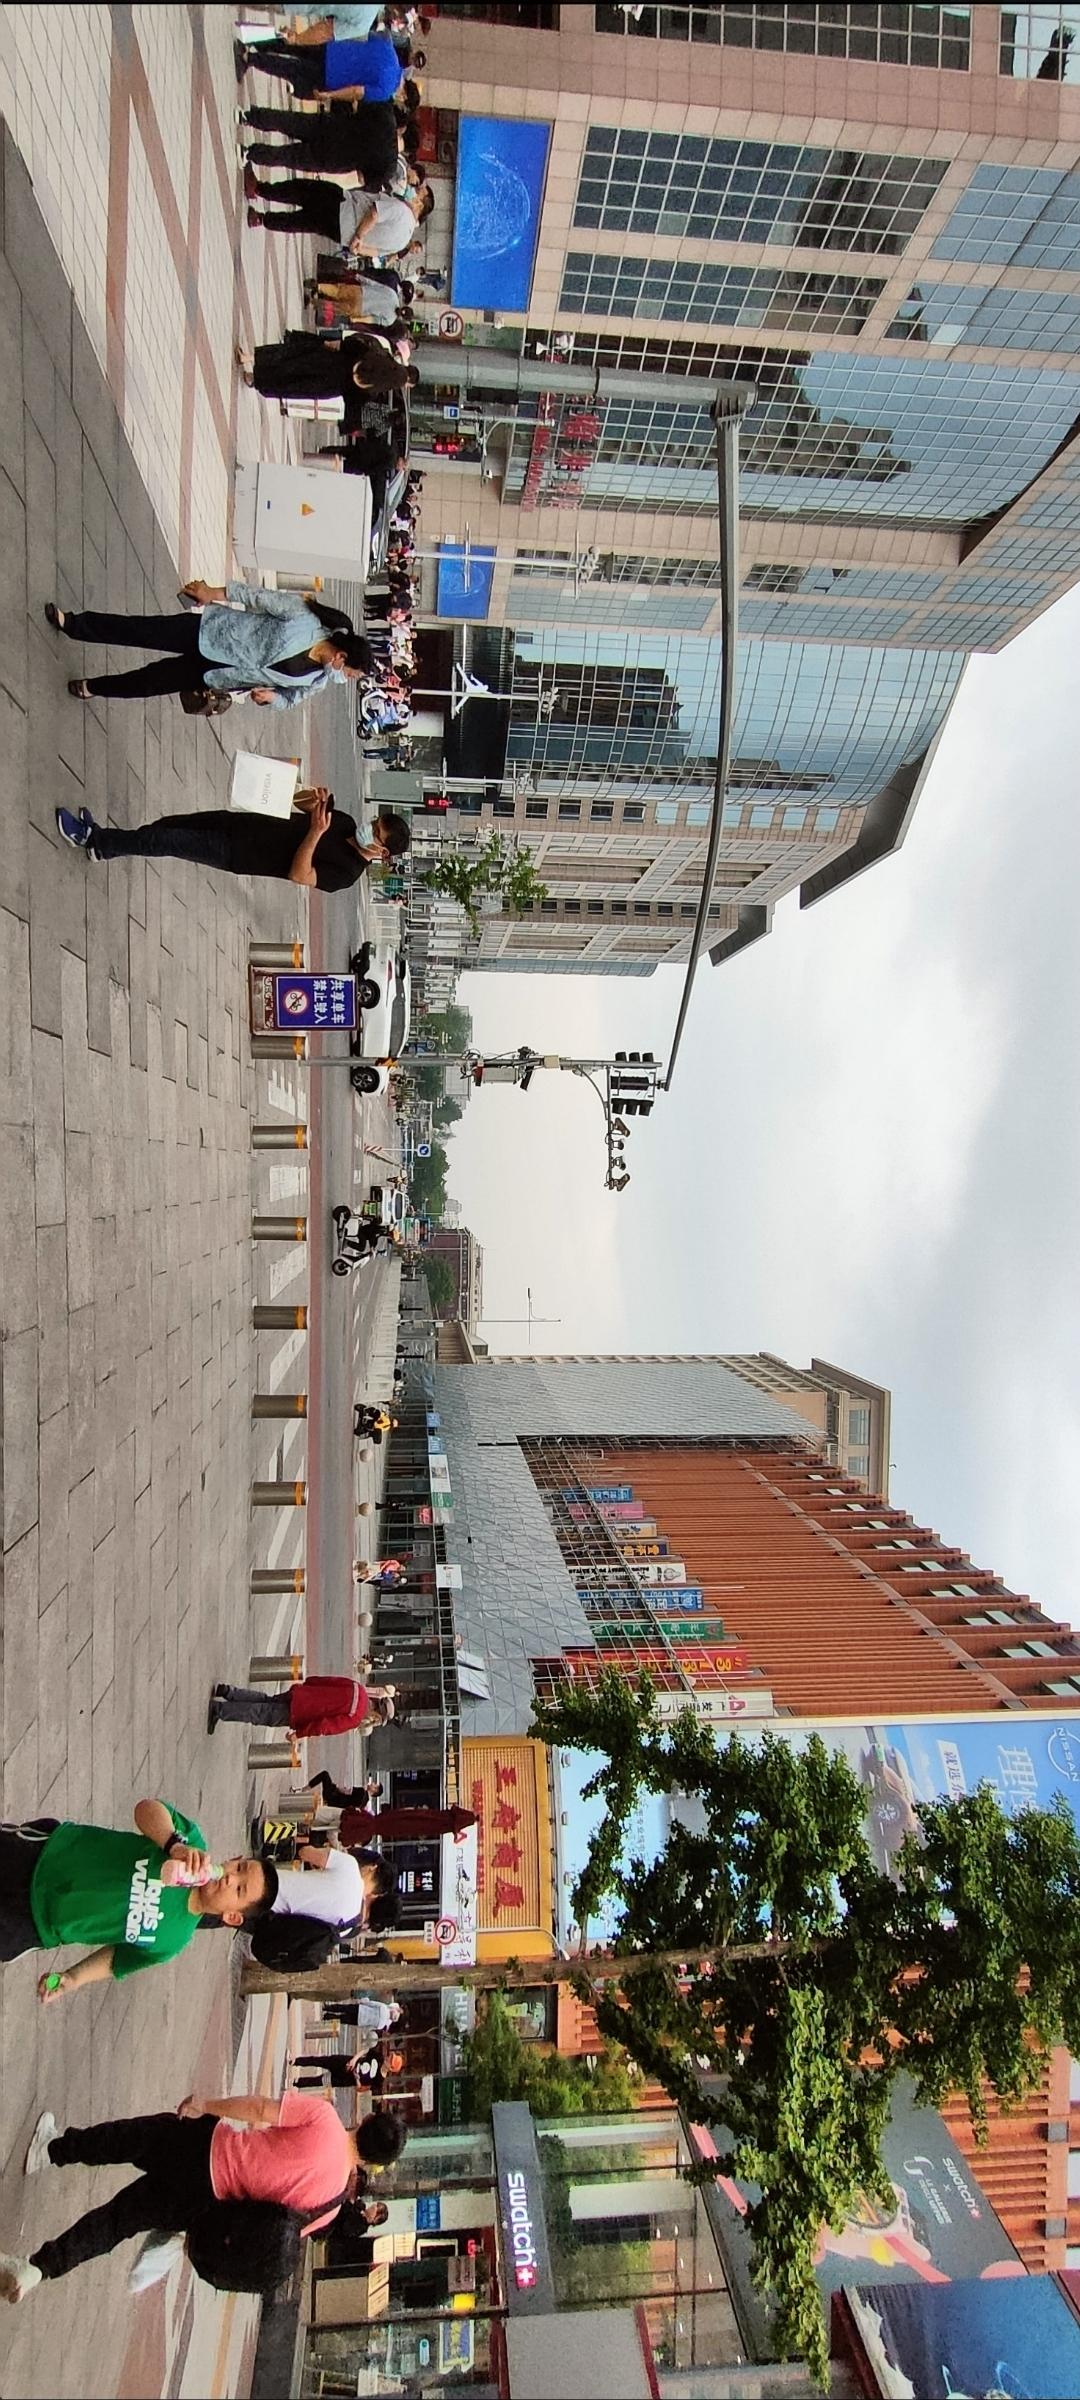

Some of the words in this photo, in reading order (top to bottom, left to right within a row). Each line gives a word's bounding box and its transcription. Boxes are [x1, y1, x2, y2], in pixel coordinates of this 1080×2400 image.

[313, 980, 328, 1024] 禁止驶入
[330, 980, 345, 1024] 共享单车
[1057, 1728, 1079, 1782] NISSAN
[491, 1759, 524, 1918] 王府商厦
[941, 2157, 979, 2208] swatch
[508, 2173, 537, 2268] swatch
